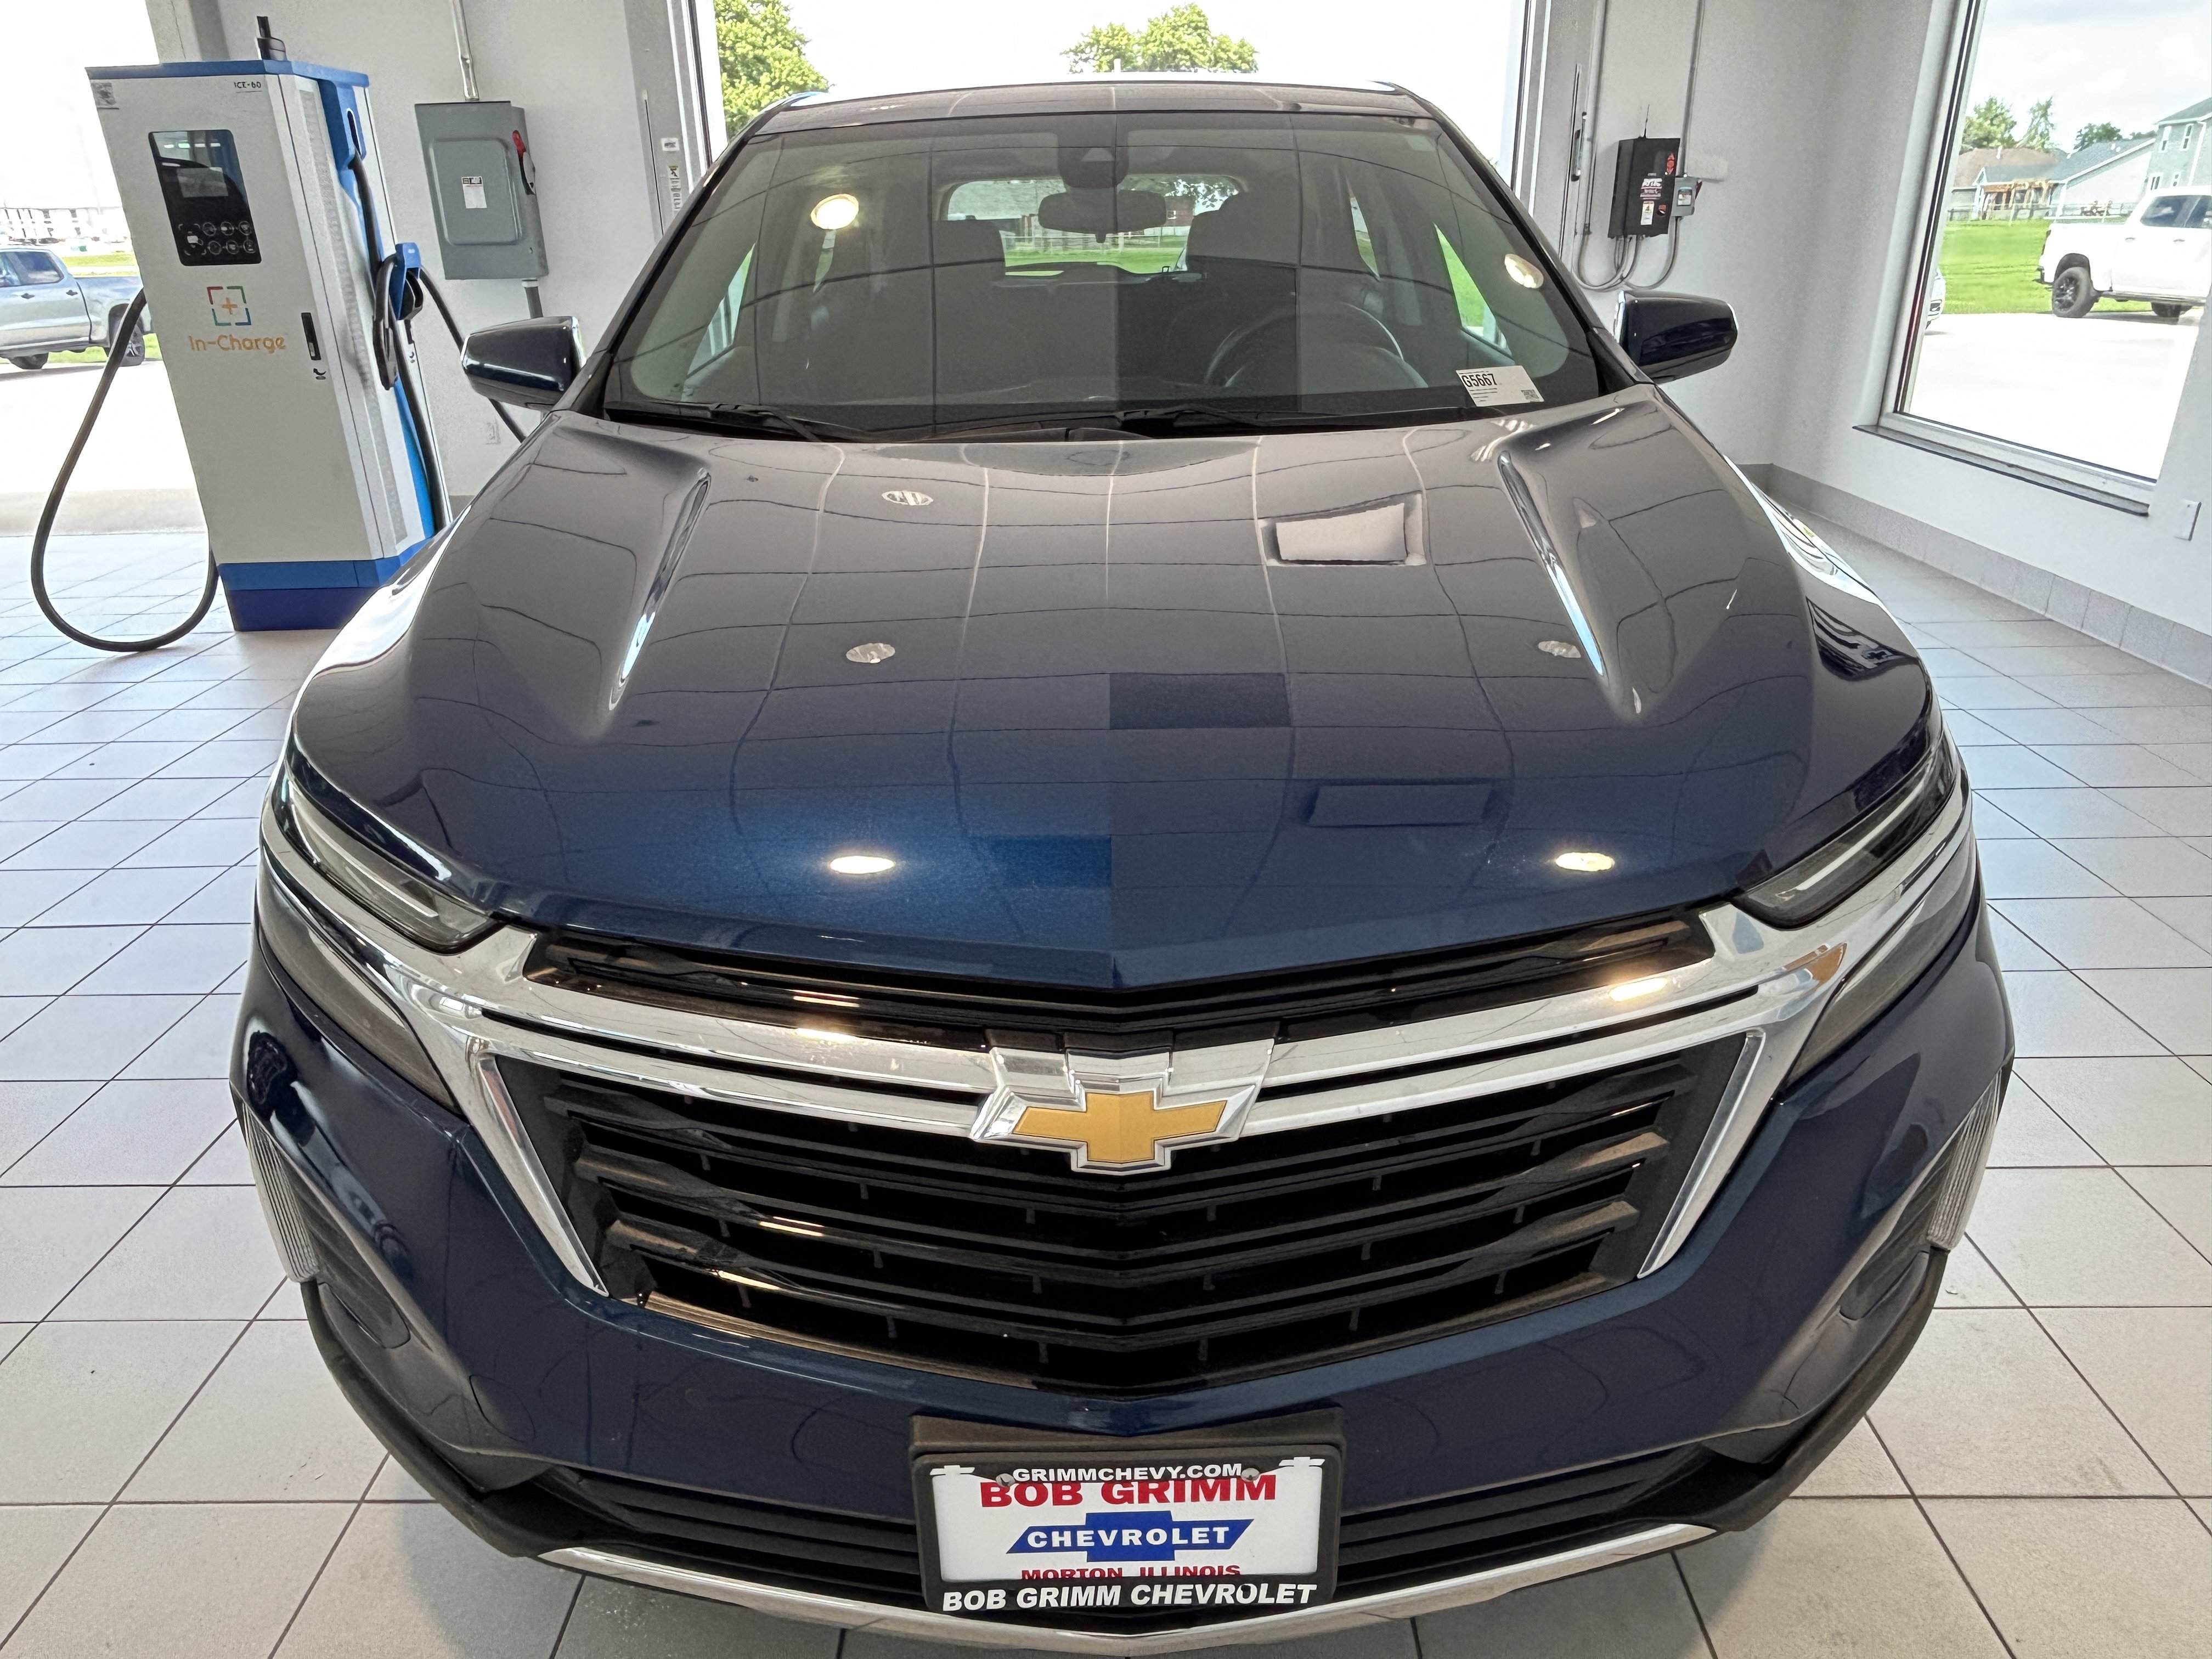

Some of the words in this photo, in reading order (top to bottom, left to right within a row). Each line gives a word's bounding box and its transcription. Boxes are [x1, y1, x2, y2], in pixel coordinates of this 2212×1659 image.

[188, 334, 286, 354] In-Charge
[1462, 373, 1498, 387] G5667
[1013, 1463, 1242, 1481] GRIMMCHEVY.COM
[980, 1482, 1083, 1507] BOB
[1101, 1475, 1276, 1504] GRIMM
[1027, 1527, 1229, 1548] CHEVROLET
[1022, 1567, 1122, 1580] MORTON
[943, 1589, 1006, 1611] BOB
[1017, 1585, 1121, 1609] GRIMM
[1131, 1583, 1317, 1605] CHEVROLET
